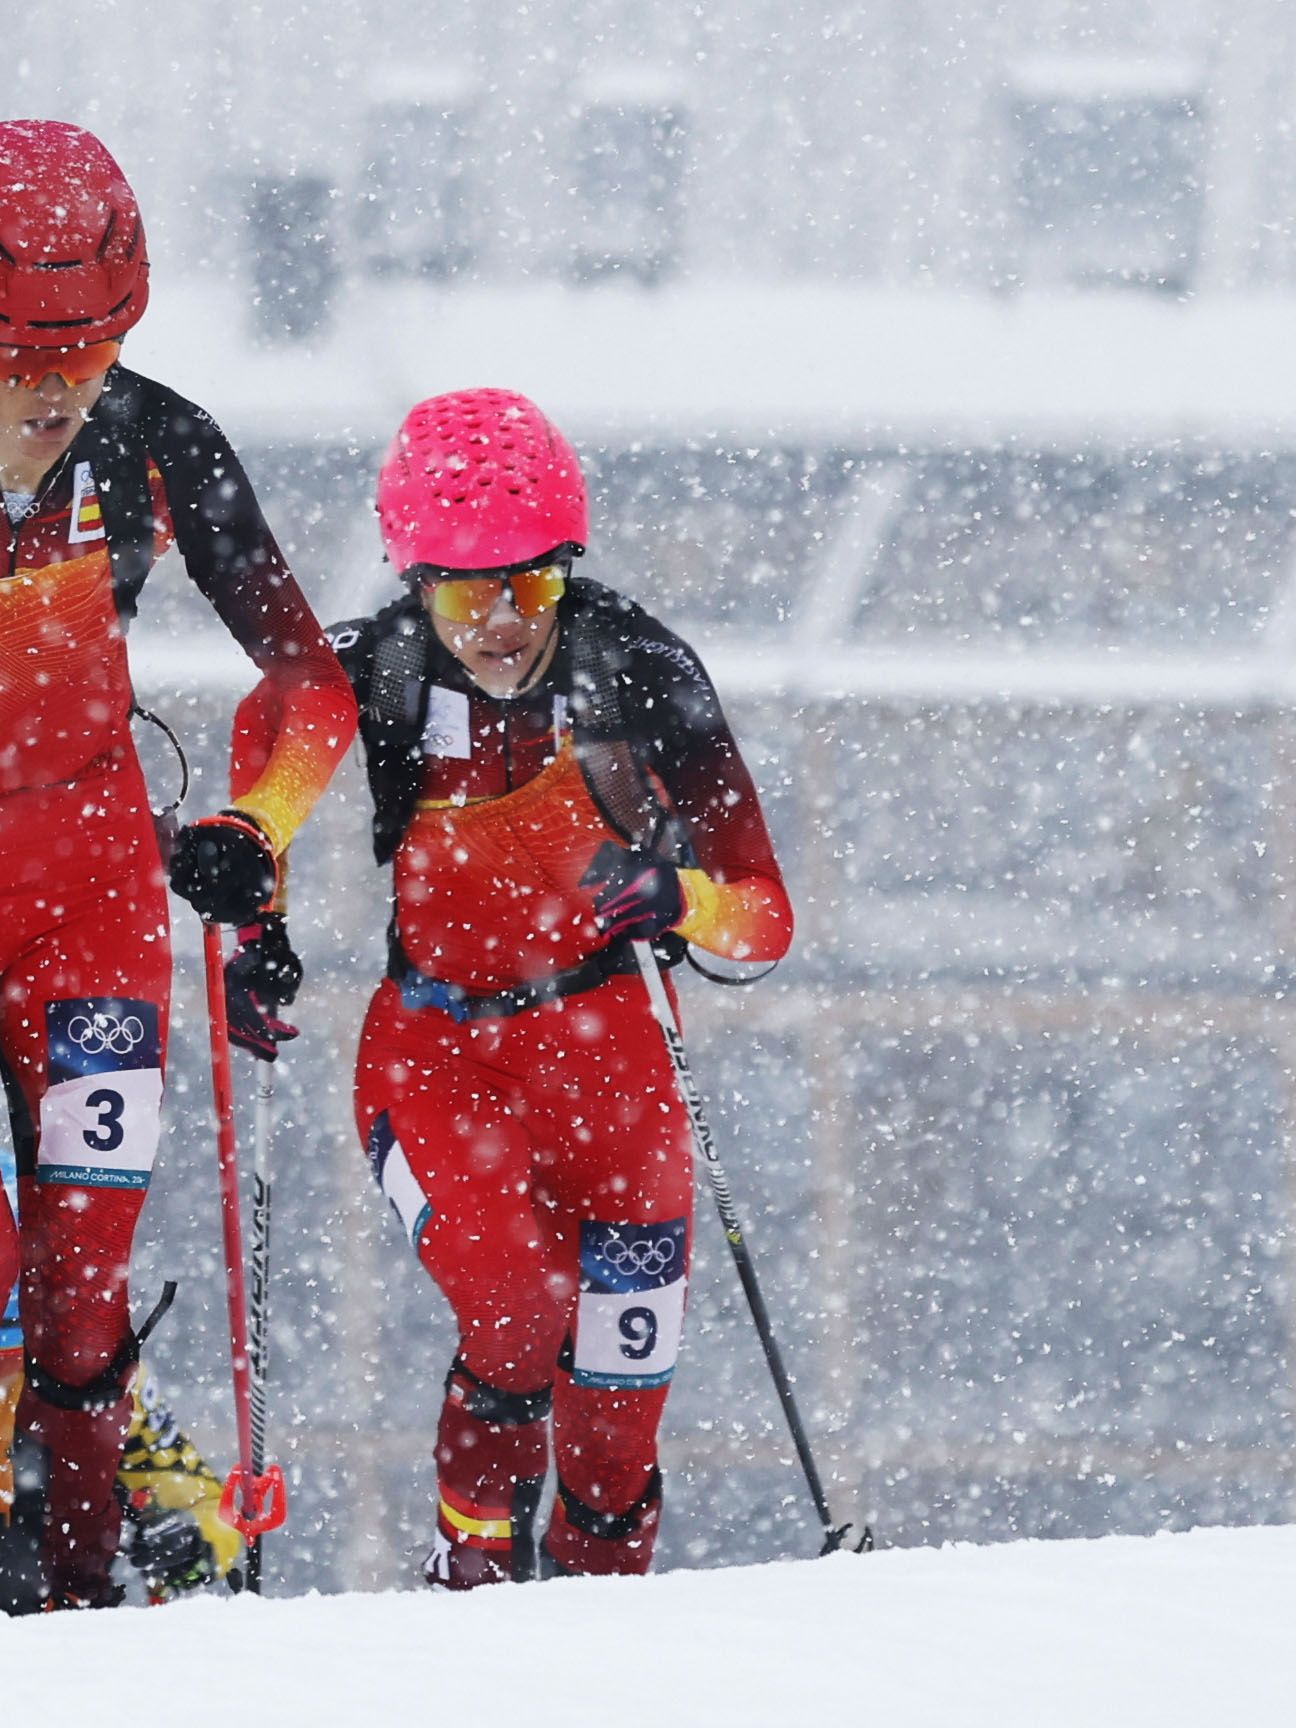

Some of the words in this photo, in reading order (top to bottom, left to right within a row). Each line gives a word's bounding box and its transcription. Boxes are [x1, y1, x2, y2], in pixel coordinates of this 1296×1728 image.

[82, 1088, 125, 1151] 3
[49, 1170, 90, 1181] MILANO
[90, 1172, 131, 1184] CORTINA
[618, 1306, 658, 1360] 9
